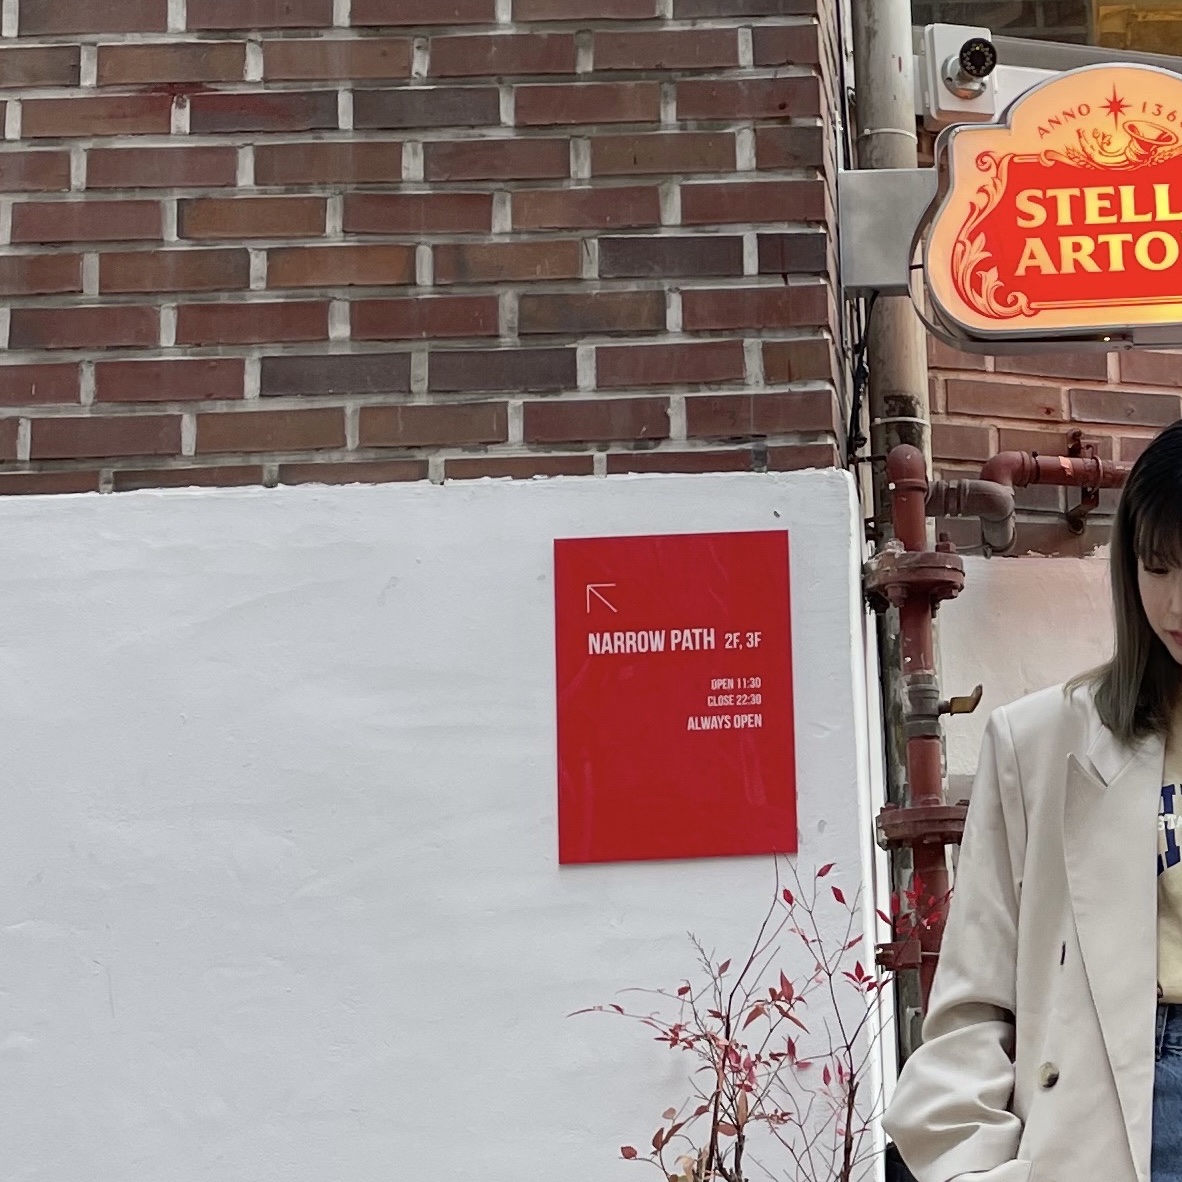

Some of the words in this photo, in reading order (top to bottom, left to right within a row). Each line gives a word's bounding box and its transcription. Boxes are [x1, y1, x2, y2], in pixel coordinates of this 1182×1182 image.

[1036, 103, 1091, 140] ANNO
[587, 629, 666, 655] NARROW
[670, 627, 716, 651] PATH
[724, 632, 743, 650] 2F,
[745, 631, 762, 649] 3F
[710, 678, 734, 691] OPEN
[736, 676, 762, 690] 11:30
[707, 694, 735, 707] CLOSE
[736, 693, 762, 706] 22:30
[687, 714, 732, 731] ALWAYS
[733, 713, 763, 729] OPEN
